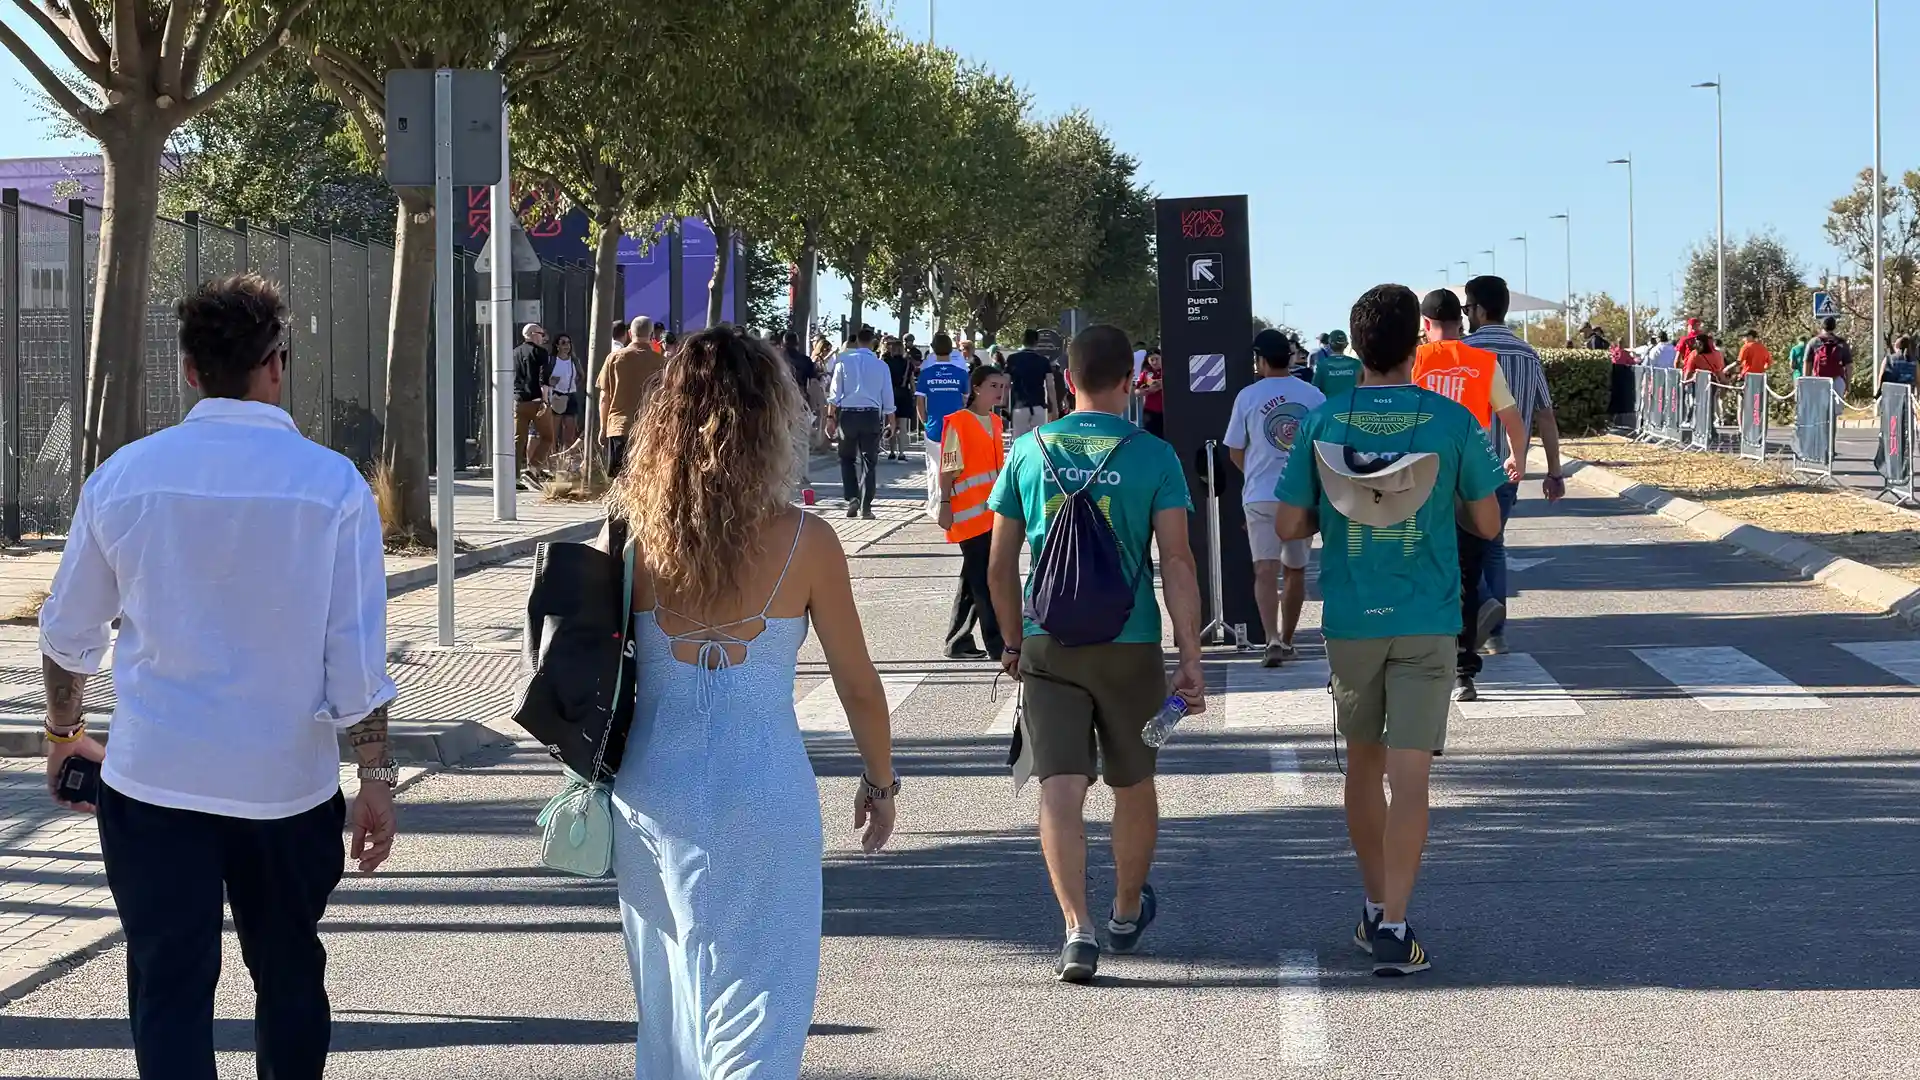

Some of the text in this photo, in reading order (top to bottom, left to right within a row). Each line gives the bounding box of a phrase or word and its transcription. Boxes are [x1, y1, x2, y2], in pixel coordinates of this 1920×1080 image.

[1187, 297, 1219, 305] Puerta
[1187, 306, 1201, 315] D5
[1427, 374, 1467, 404] STAFF
[1260, 395, 1286, 415] LEVI'S
[1043, 466, 1121, 485] aramco
